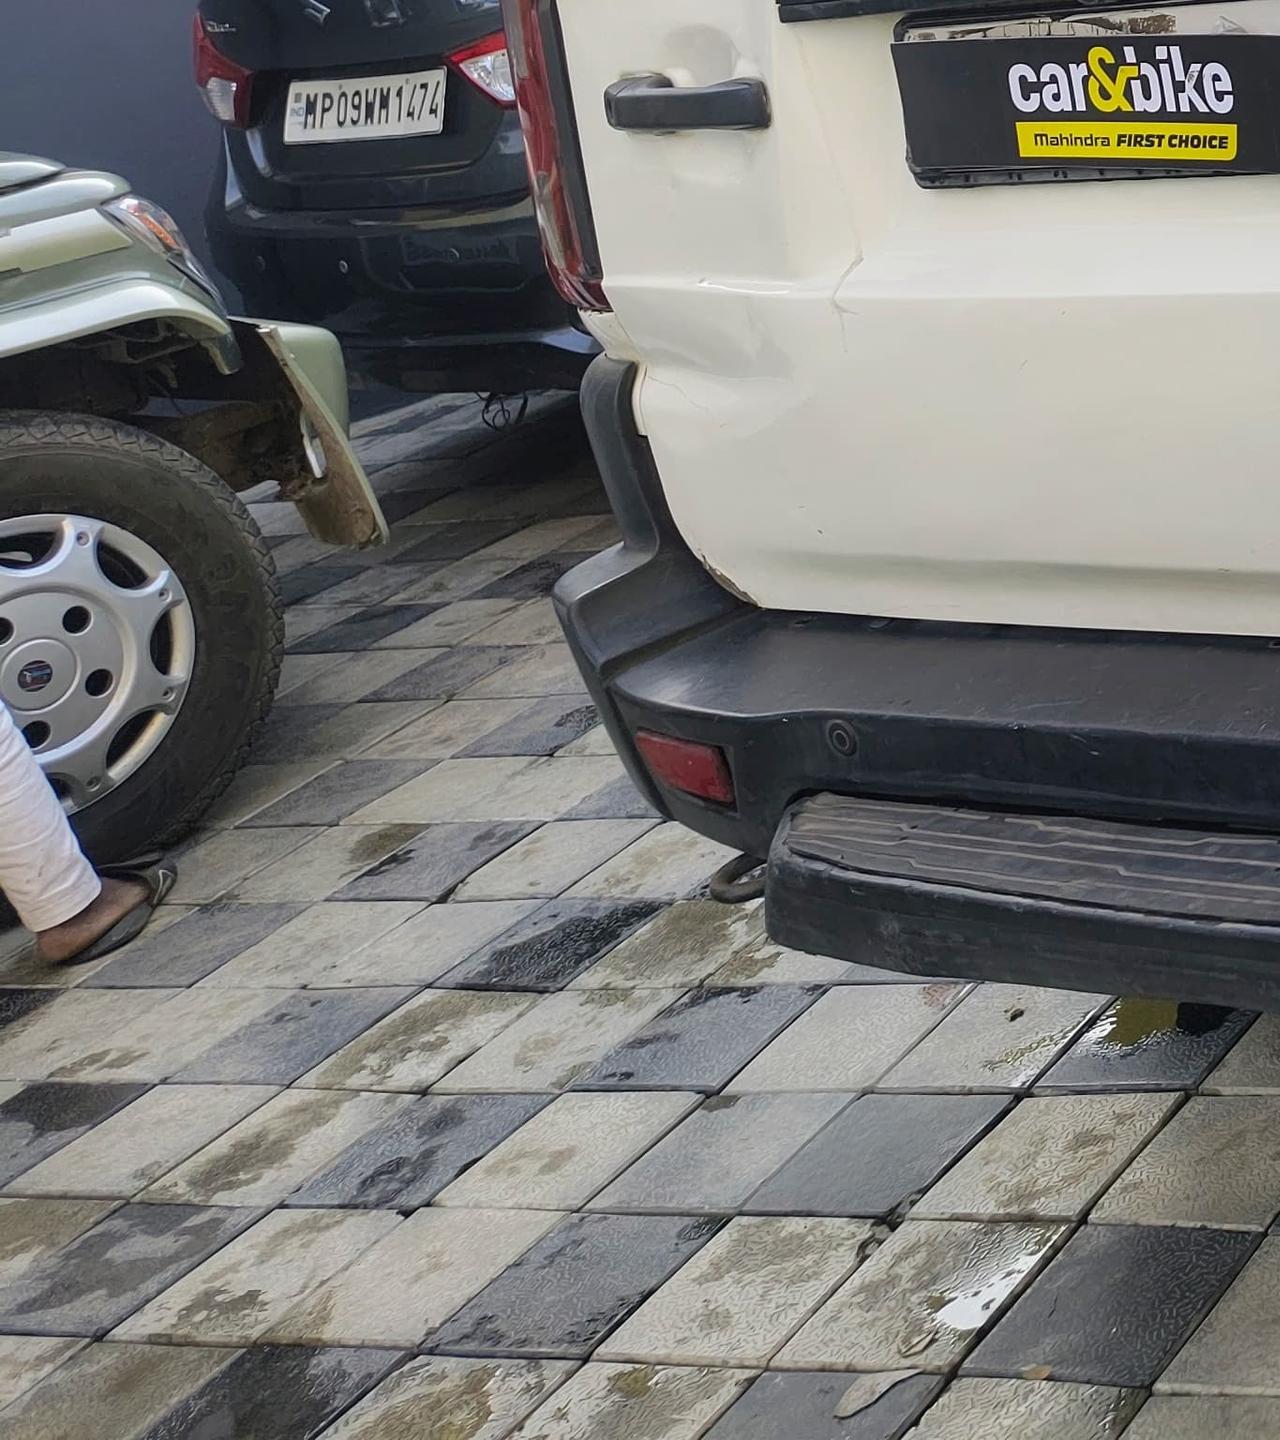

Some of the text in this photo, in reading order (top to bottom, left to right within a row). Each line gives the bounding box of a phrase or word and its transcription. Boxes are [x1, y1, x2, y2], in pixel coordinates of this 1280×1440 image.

[303, 79, 440, 130] MP09WM1474
[1007, 45, 1235, 115] car&bike
[1033, 132, 1230, 150] Mahindra FIRST CHOICE
